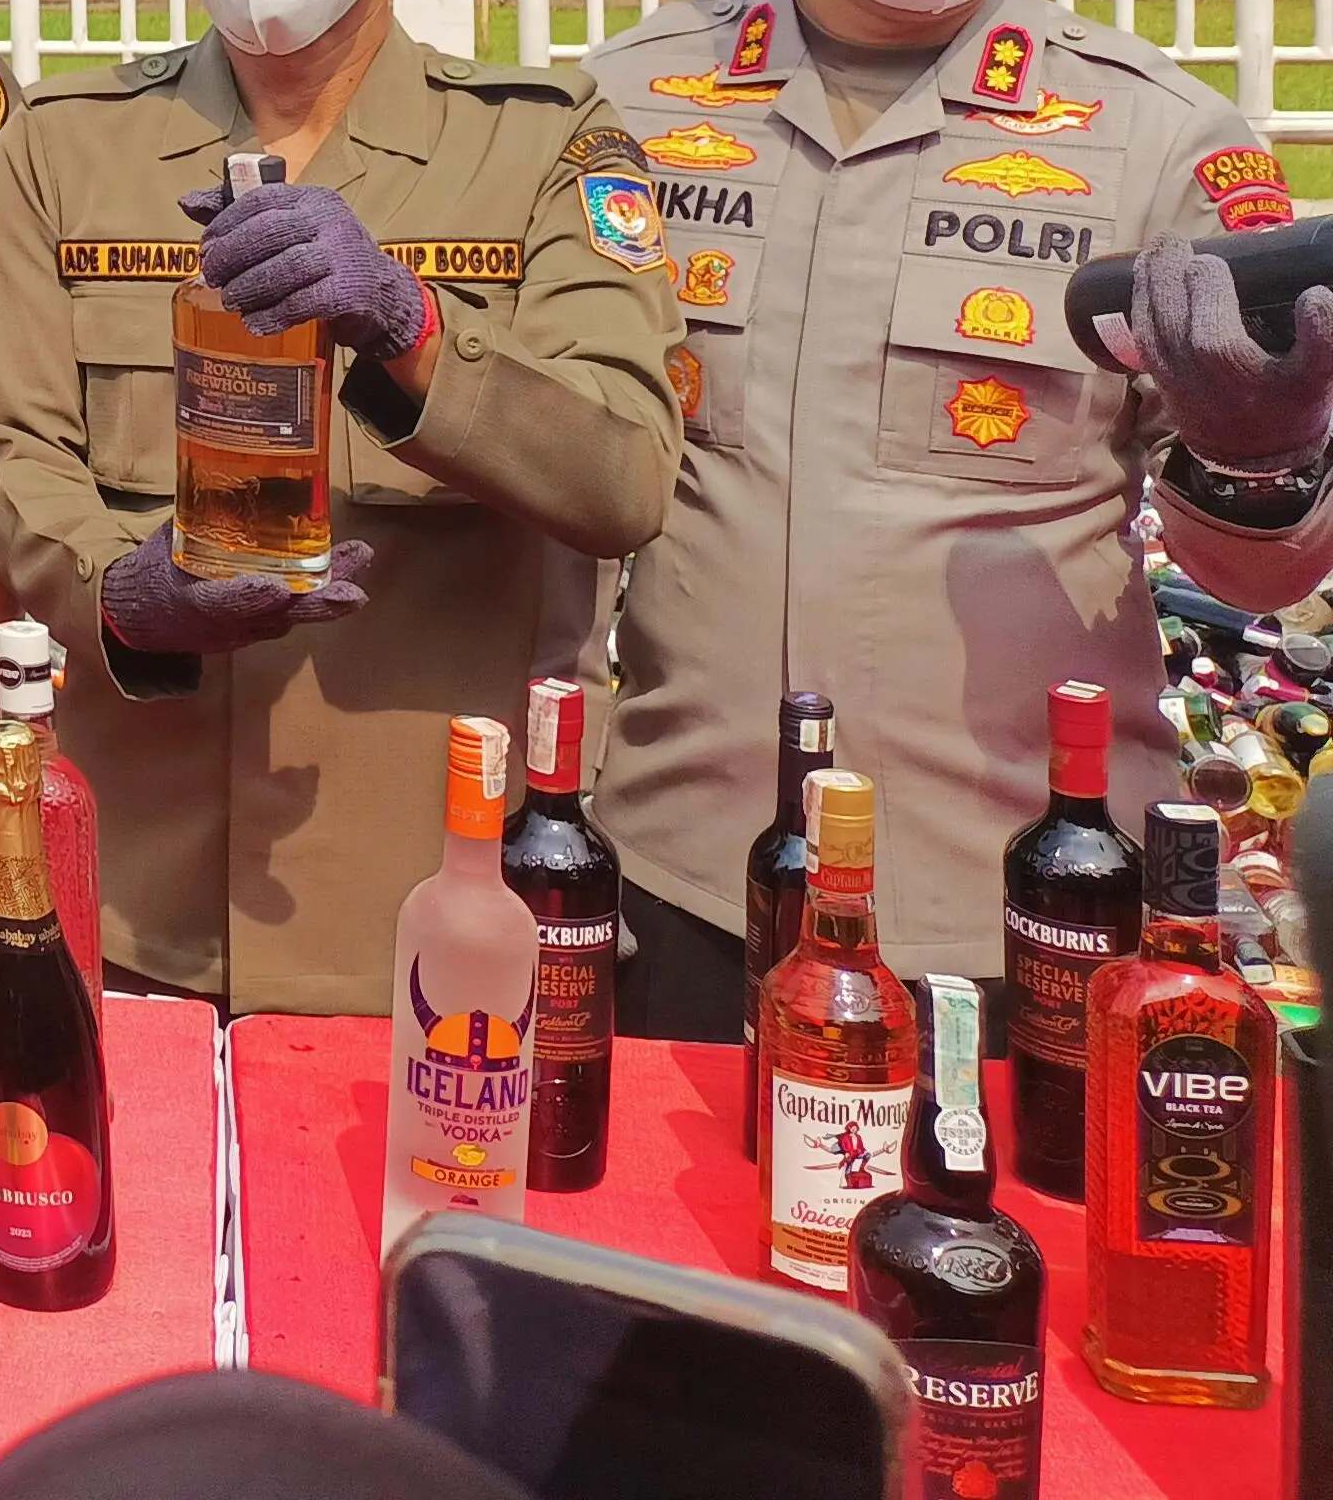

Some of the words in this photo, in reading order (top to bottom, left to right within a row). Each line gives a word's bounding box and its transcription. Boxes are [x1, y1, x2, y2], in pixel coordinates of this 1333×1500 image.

[1216, 167, 1275, 190] BOGOR
[656, 181, 754, 228] IKHA
[1229, 201, 1255, 220] JAWA
[1255, 199, 1289, 213] BARAT
[925, 210, 1093, 266] POLRI
[64, 245, 100, 273] ADE
[107, 244, 204, 274] RUHAND
[434, 244, 517, 275] BOGOR
[970, 325, 1019, 342] POLRI
[202, 359, 251, 380] ROYAL
[186, 369, 278, 397] BREWHOUSE
[820, 867, 860, 890] Captain
[1016, 953, 1084, 987] SPECIAL
[1016, 969, 1084, 1004] RESERVE
[549, 998, 580, 1009] PORT
[406, 1056, 529, 1112] ICELAND
[417, 1101, 461, 1124] TRIPLE
[464, 1111, 520, 1126] DISTILLED
[777, 1083, 850, 1124] Captain
[856, 1097, 911, 1130] Morga
[1165, 1102, 1200, 1113] BLACK
[1202, 1104, 1223, 1115] TEA
[440, 1122, 502, 1143] VODKA
[434, 1169, 501, 1187] ORANGE
[822, 1197, 867, 1206] ORIGIN
[9, 1226, 33, 1238] 2023
[902, 1362, 1039, 1408] RESERVE
